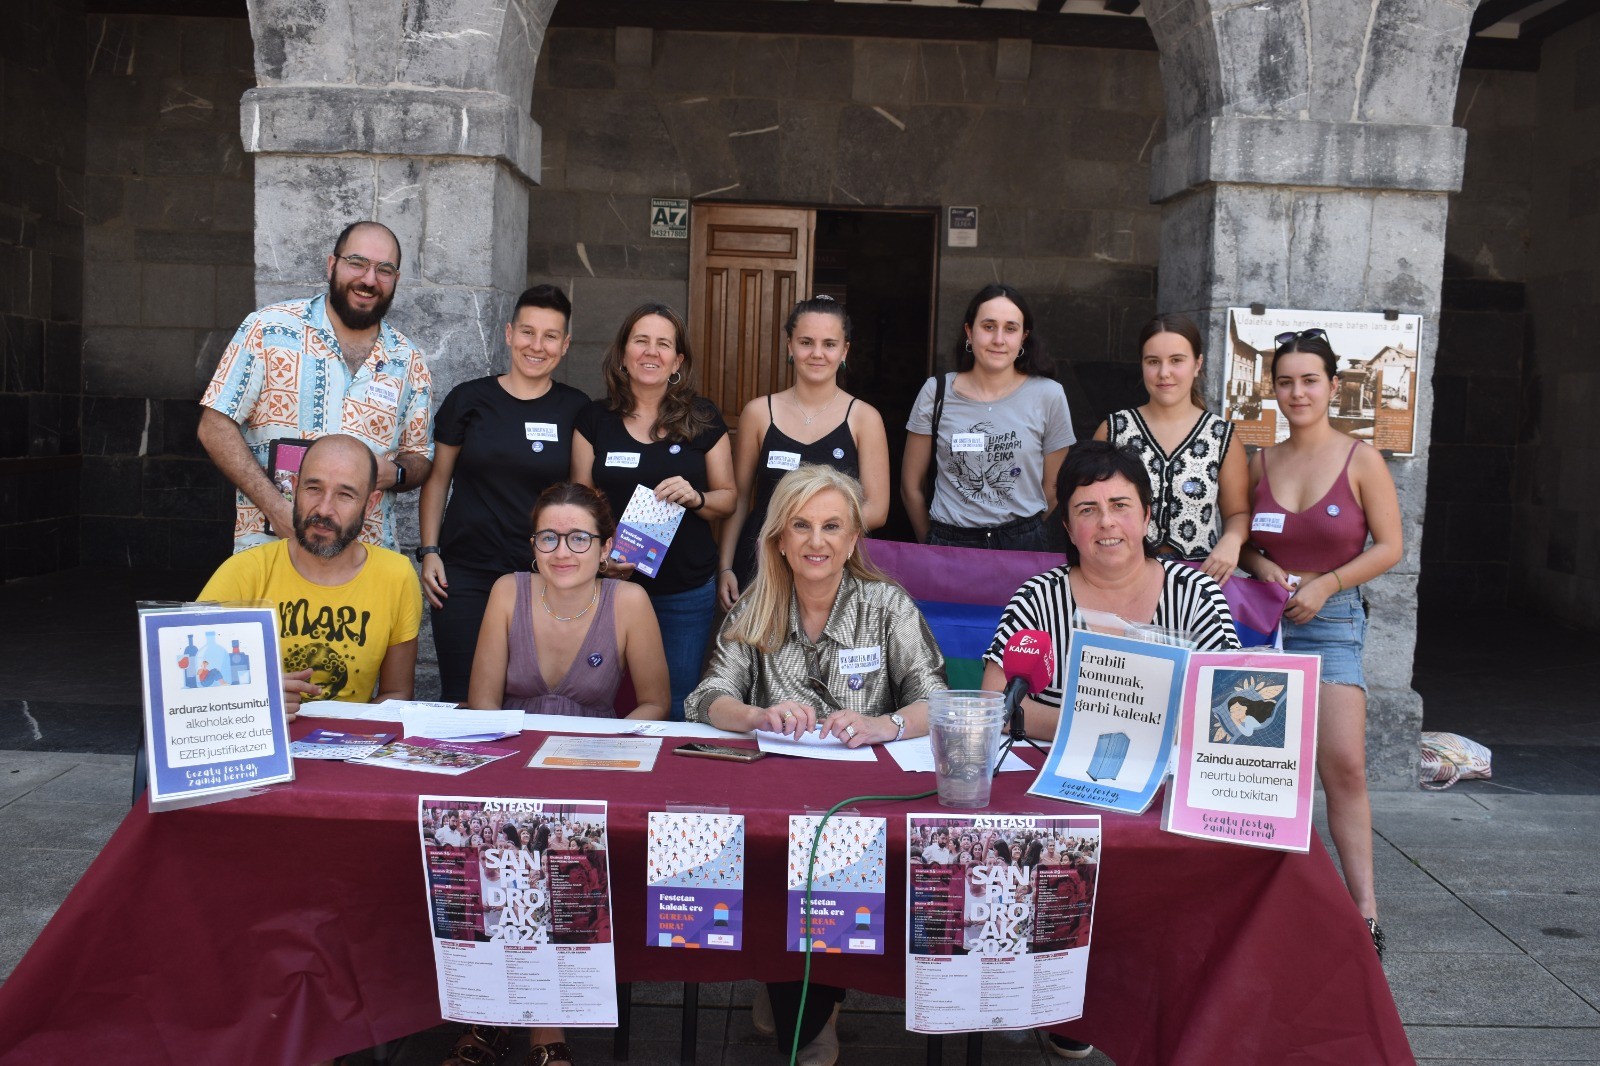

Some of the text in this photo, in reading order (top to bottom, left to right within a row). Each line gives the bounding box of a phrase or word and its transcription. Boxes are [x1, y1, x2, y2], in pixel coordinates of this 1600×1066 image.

[652, 207, 687, 226] A7
[988, 430, 1017, 445] LURRA
[987, 451, 1014, 462] DEIKA
[1008, 645, 1041, 655] KANALA
[1080, 650, 1126, 670] Erabili
[1078, 667, 1144, 690] komunak,
[1077, 684, 1145, 706] mantendu
[169, 698, 270, 716] arduraz kontsumitu!
[1074, 699, 1161, 725] garbi kaleak!
[186, 714, 255, 729] alkoholak edo
[171, 728, 272, 746] kontsumoek ez dute
[179, 742, 268, 760] EZER justifikatzen
[1196, 752, 1297, 770] Zaindu auzotarrak!
[186, 767, 221, 779] Gozatu
[188, 776, 221, 787] zaindu
[1200, 770, 1293, 787] neurtu bolumena
[1211, 787, 1278, 802] ordu txikitan
[483, 801, 543, 813] ASTEASU
[973, 817, 1036, 829] ASTEASU
[1202, 813, 1238, 827] Gozatu
[1203, 823, 1275, 840] zaindu herria!
[484, 848, 541, 870] SAN
[501, 869, 530, 889] PE
[972, 866, 1030, 885] SAN
[487, 887, 545, 908] DRO
[659, 893, 696, 902] Festetan
[985, 884, 1017, 904] PE
[659, 902, 689, 911] kaleak
[800, 907, 830, 916] kleak
[971, 902, 1030, 922] DRO
[499, 906, 536, 927] AK
[659, 913, 696, 921] GUREAK
[800, 917, 836, 926] GREAK
[488, 924, 549, 944] 2024
[659, 922, 685, 930] DIRA!
[800, 927, 826, 935] DRA!
[979, 920, 1018, 940] AK
[968, 938, 1029, 957] 2024
